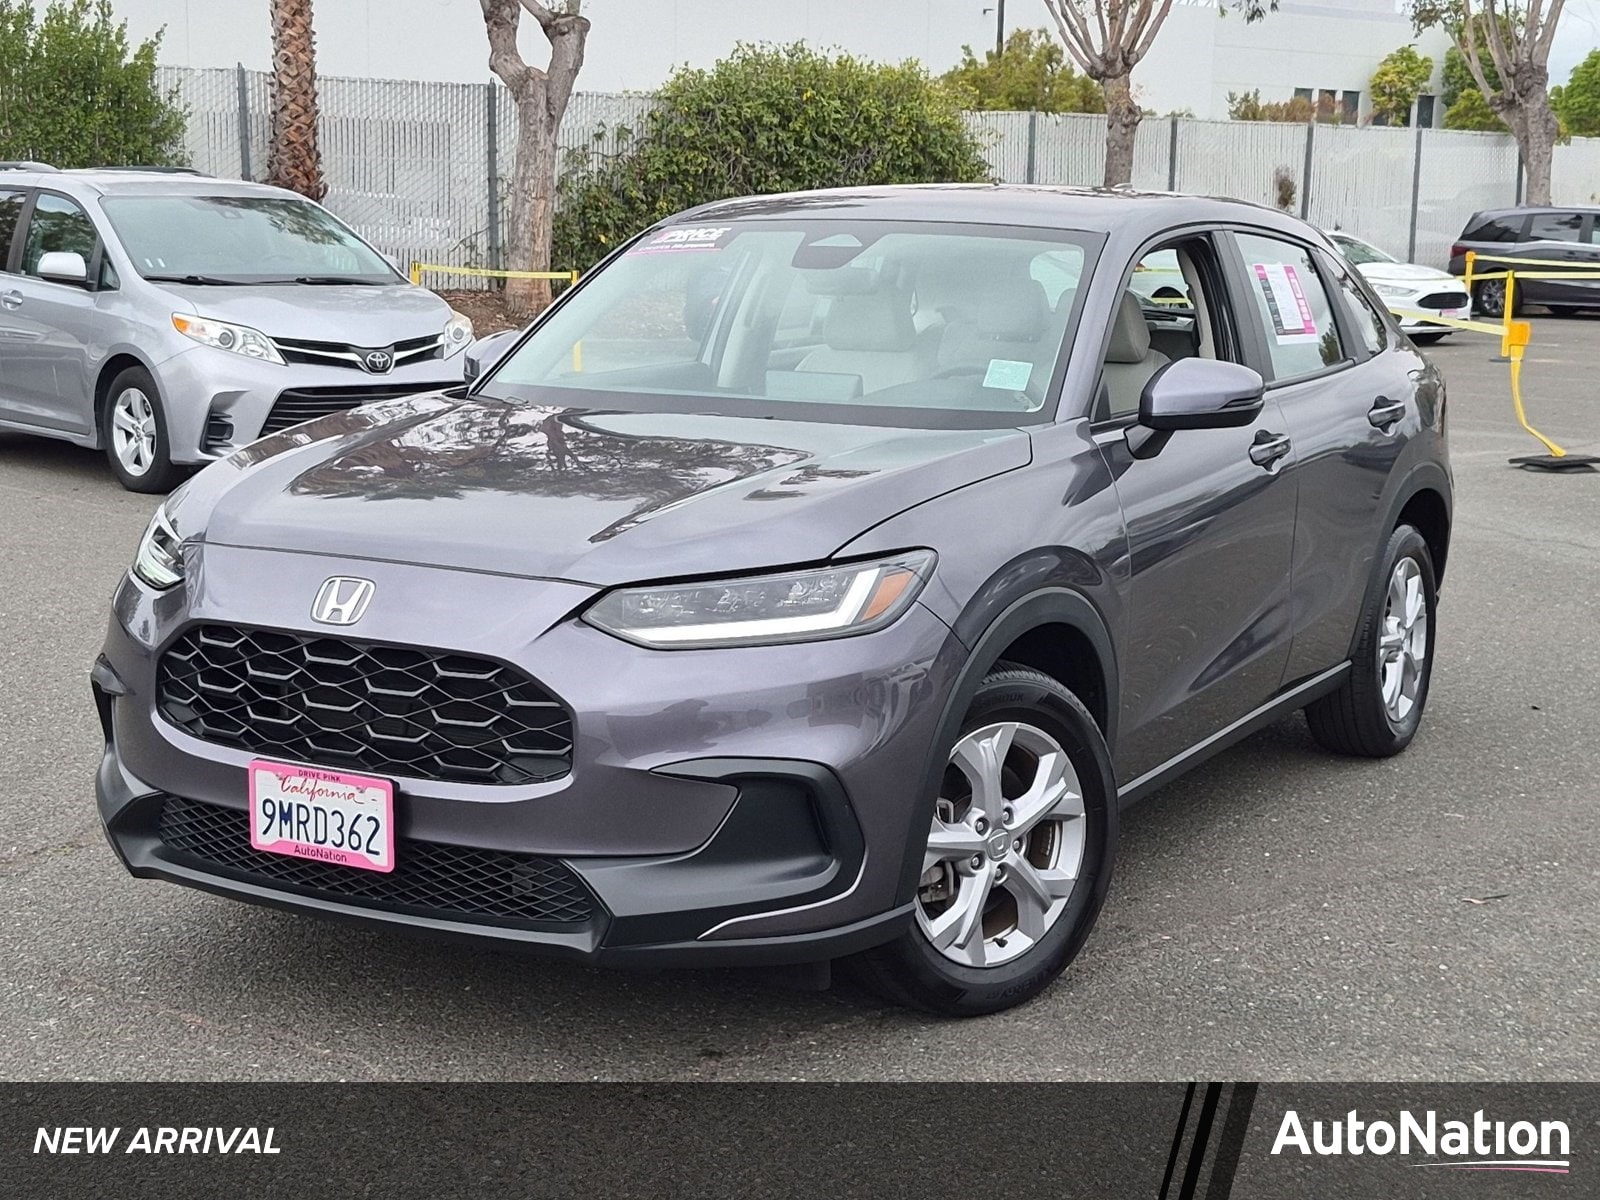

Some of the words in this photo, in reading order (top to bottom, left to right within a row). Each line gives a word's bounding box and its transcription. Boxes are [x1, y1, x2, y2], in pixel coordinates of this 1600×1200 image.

[298, 769, 321, 780] DRIVE
[323, 773, 342, 783] PINK
[281, 775, 364, 804] California
[262, 798, 380, 856] 9MRD362
[294, 845, 347, 863] AutoNation
